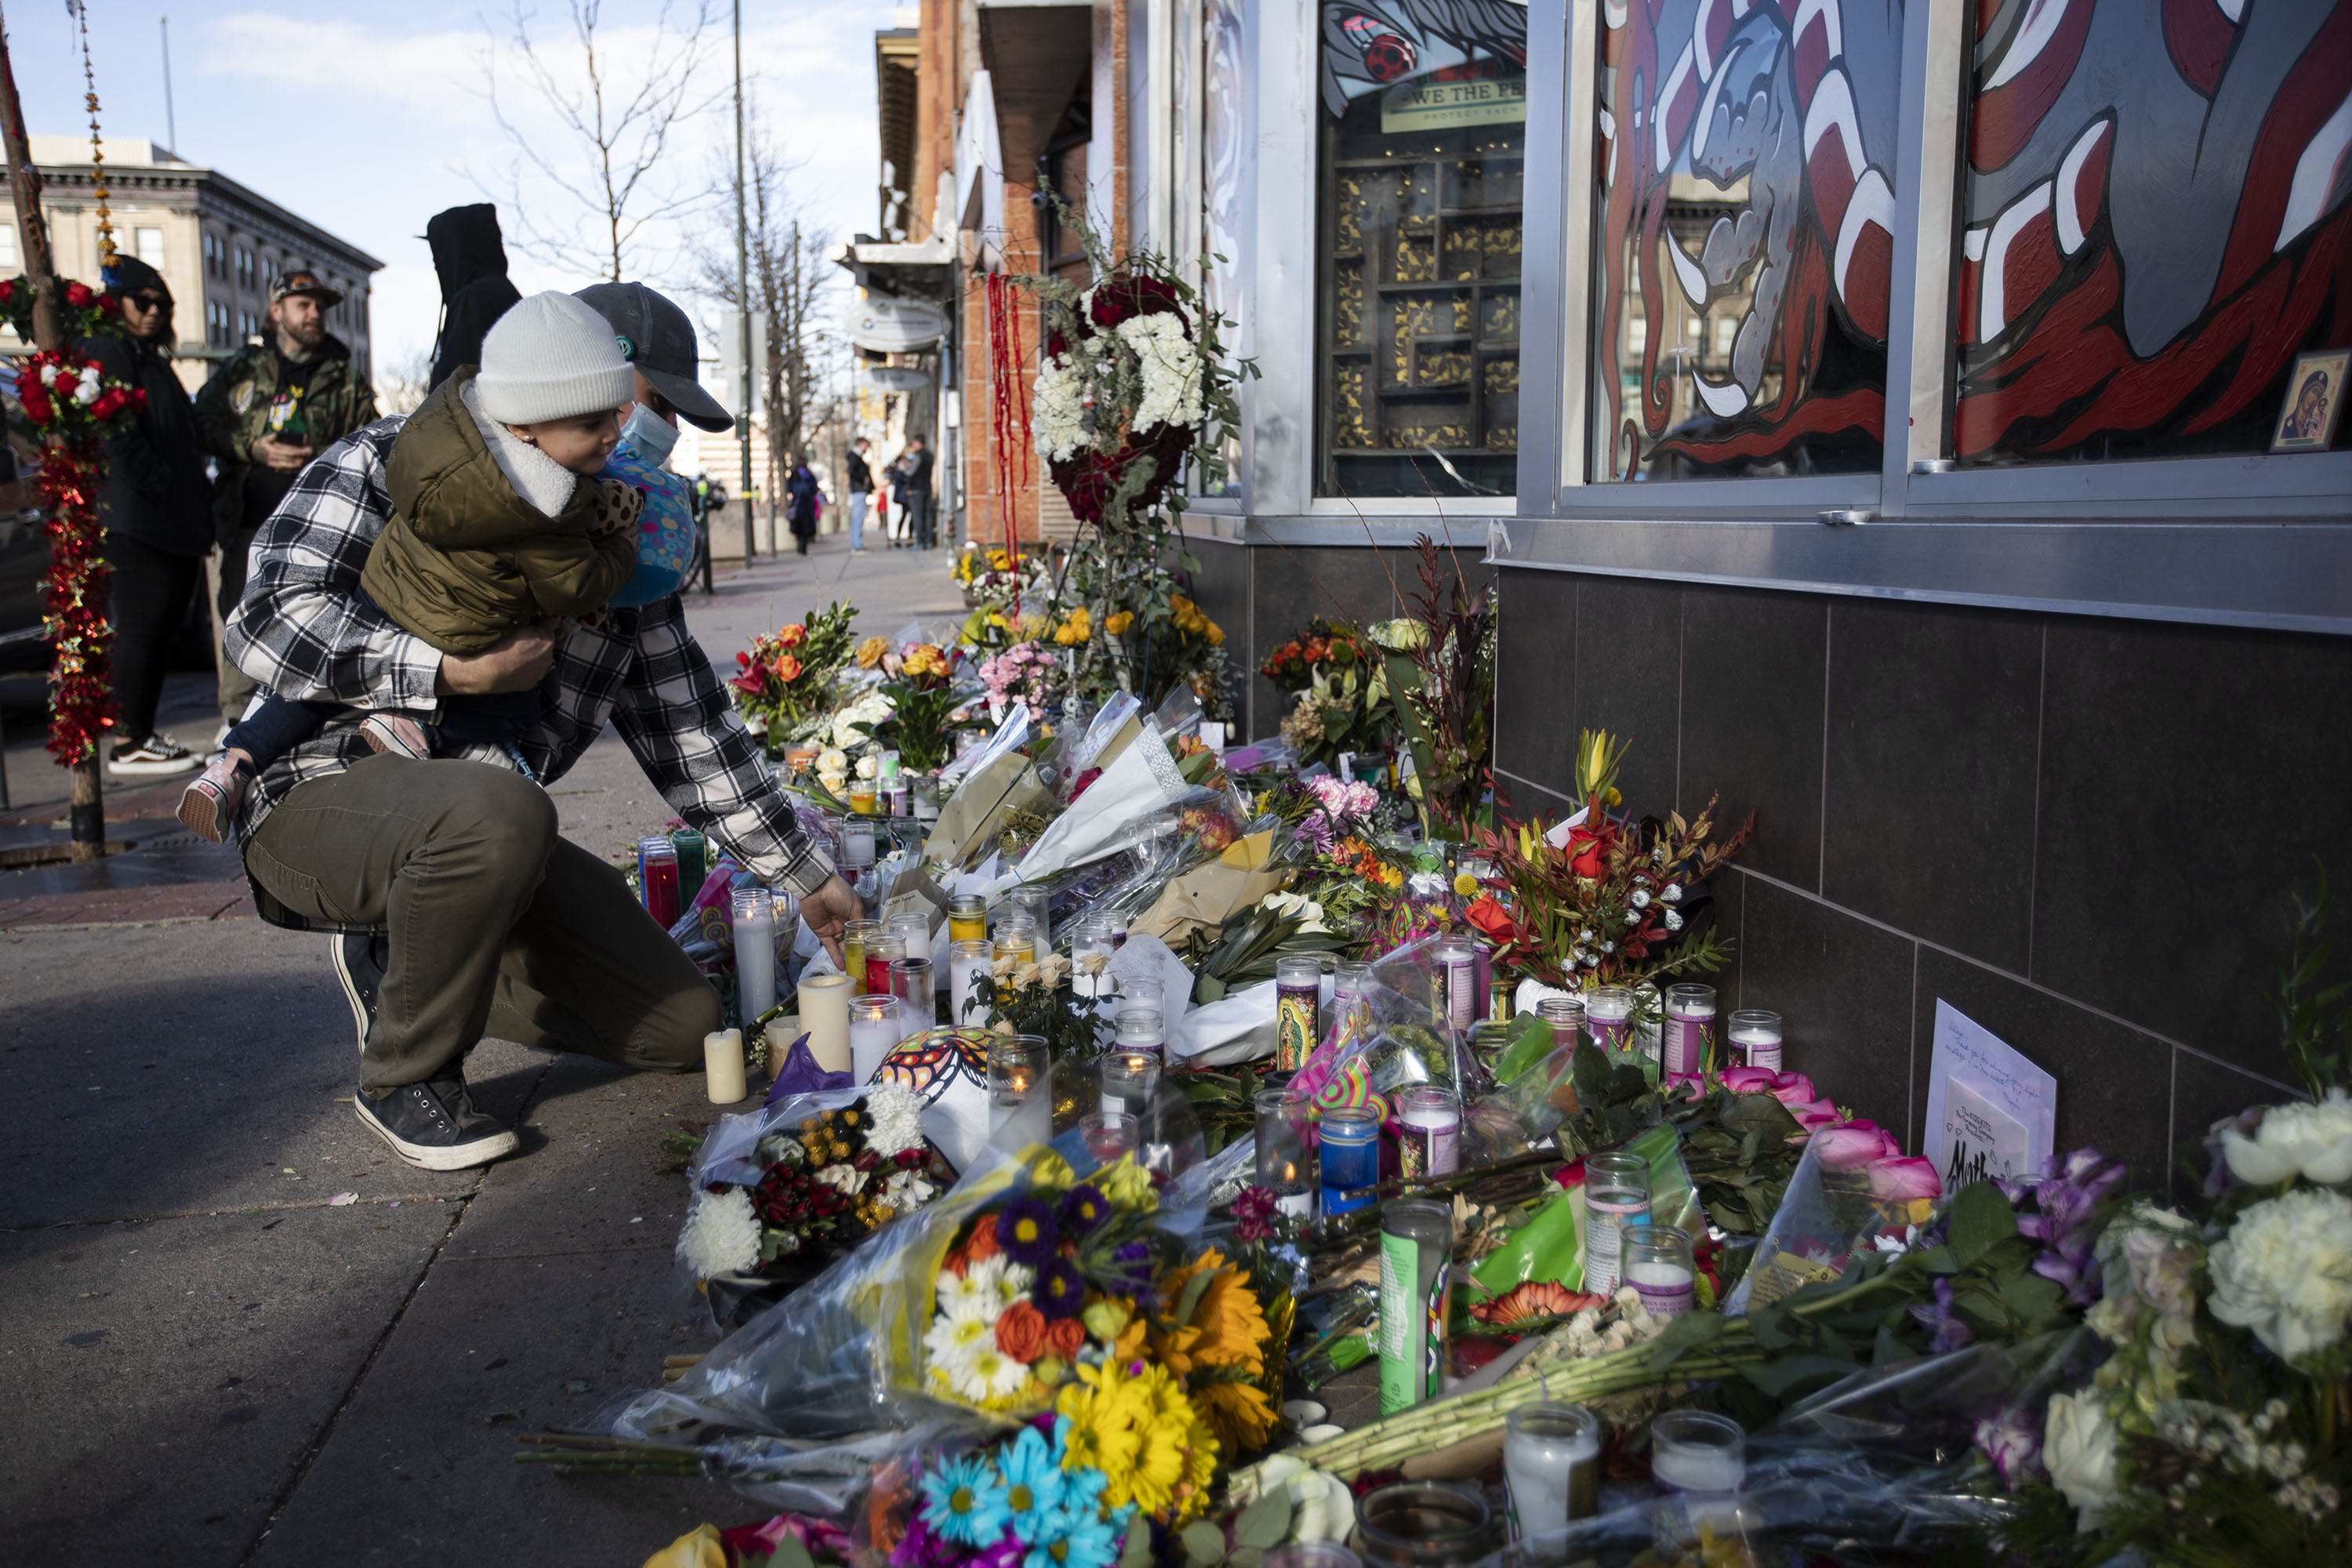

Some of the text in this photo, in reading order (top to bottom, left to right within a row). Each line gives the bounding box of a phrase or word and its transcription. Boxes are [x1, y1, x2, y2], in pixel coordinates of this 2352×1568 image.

[1412, 82, 1526, 105] WE THE PE
[1424, 107, 1519, 121] PROTECT EACH
[1956, 1109, 1995, 1145] Performing Company
